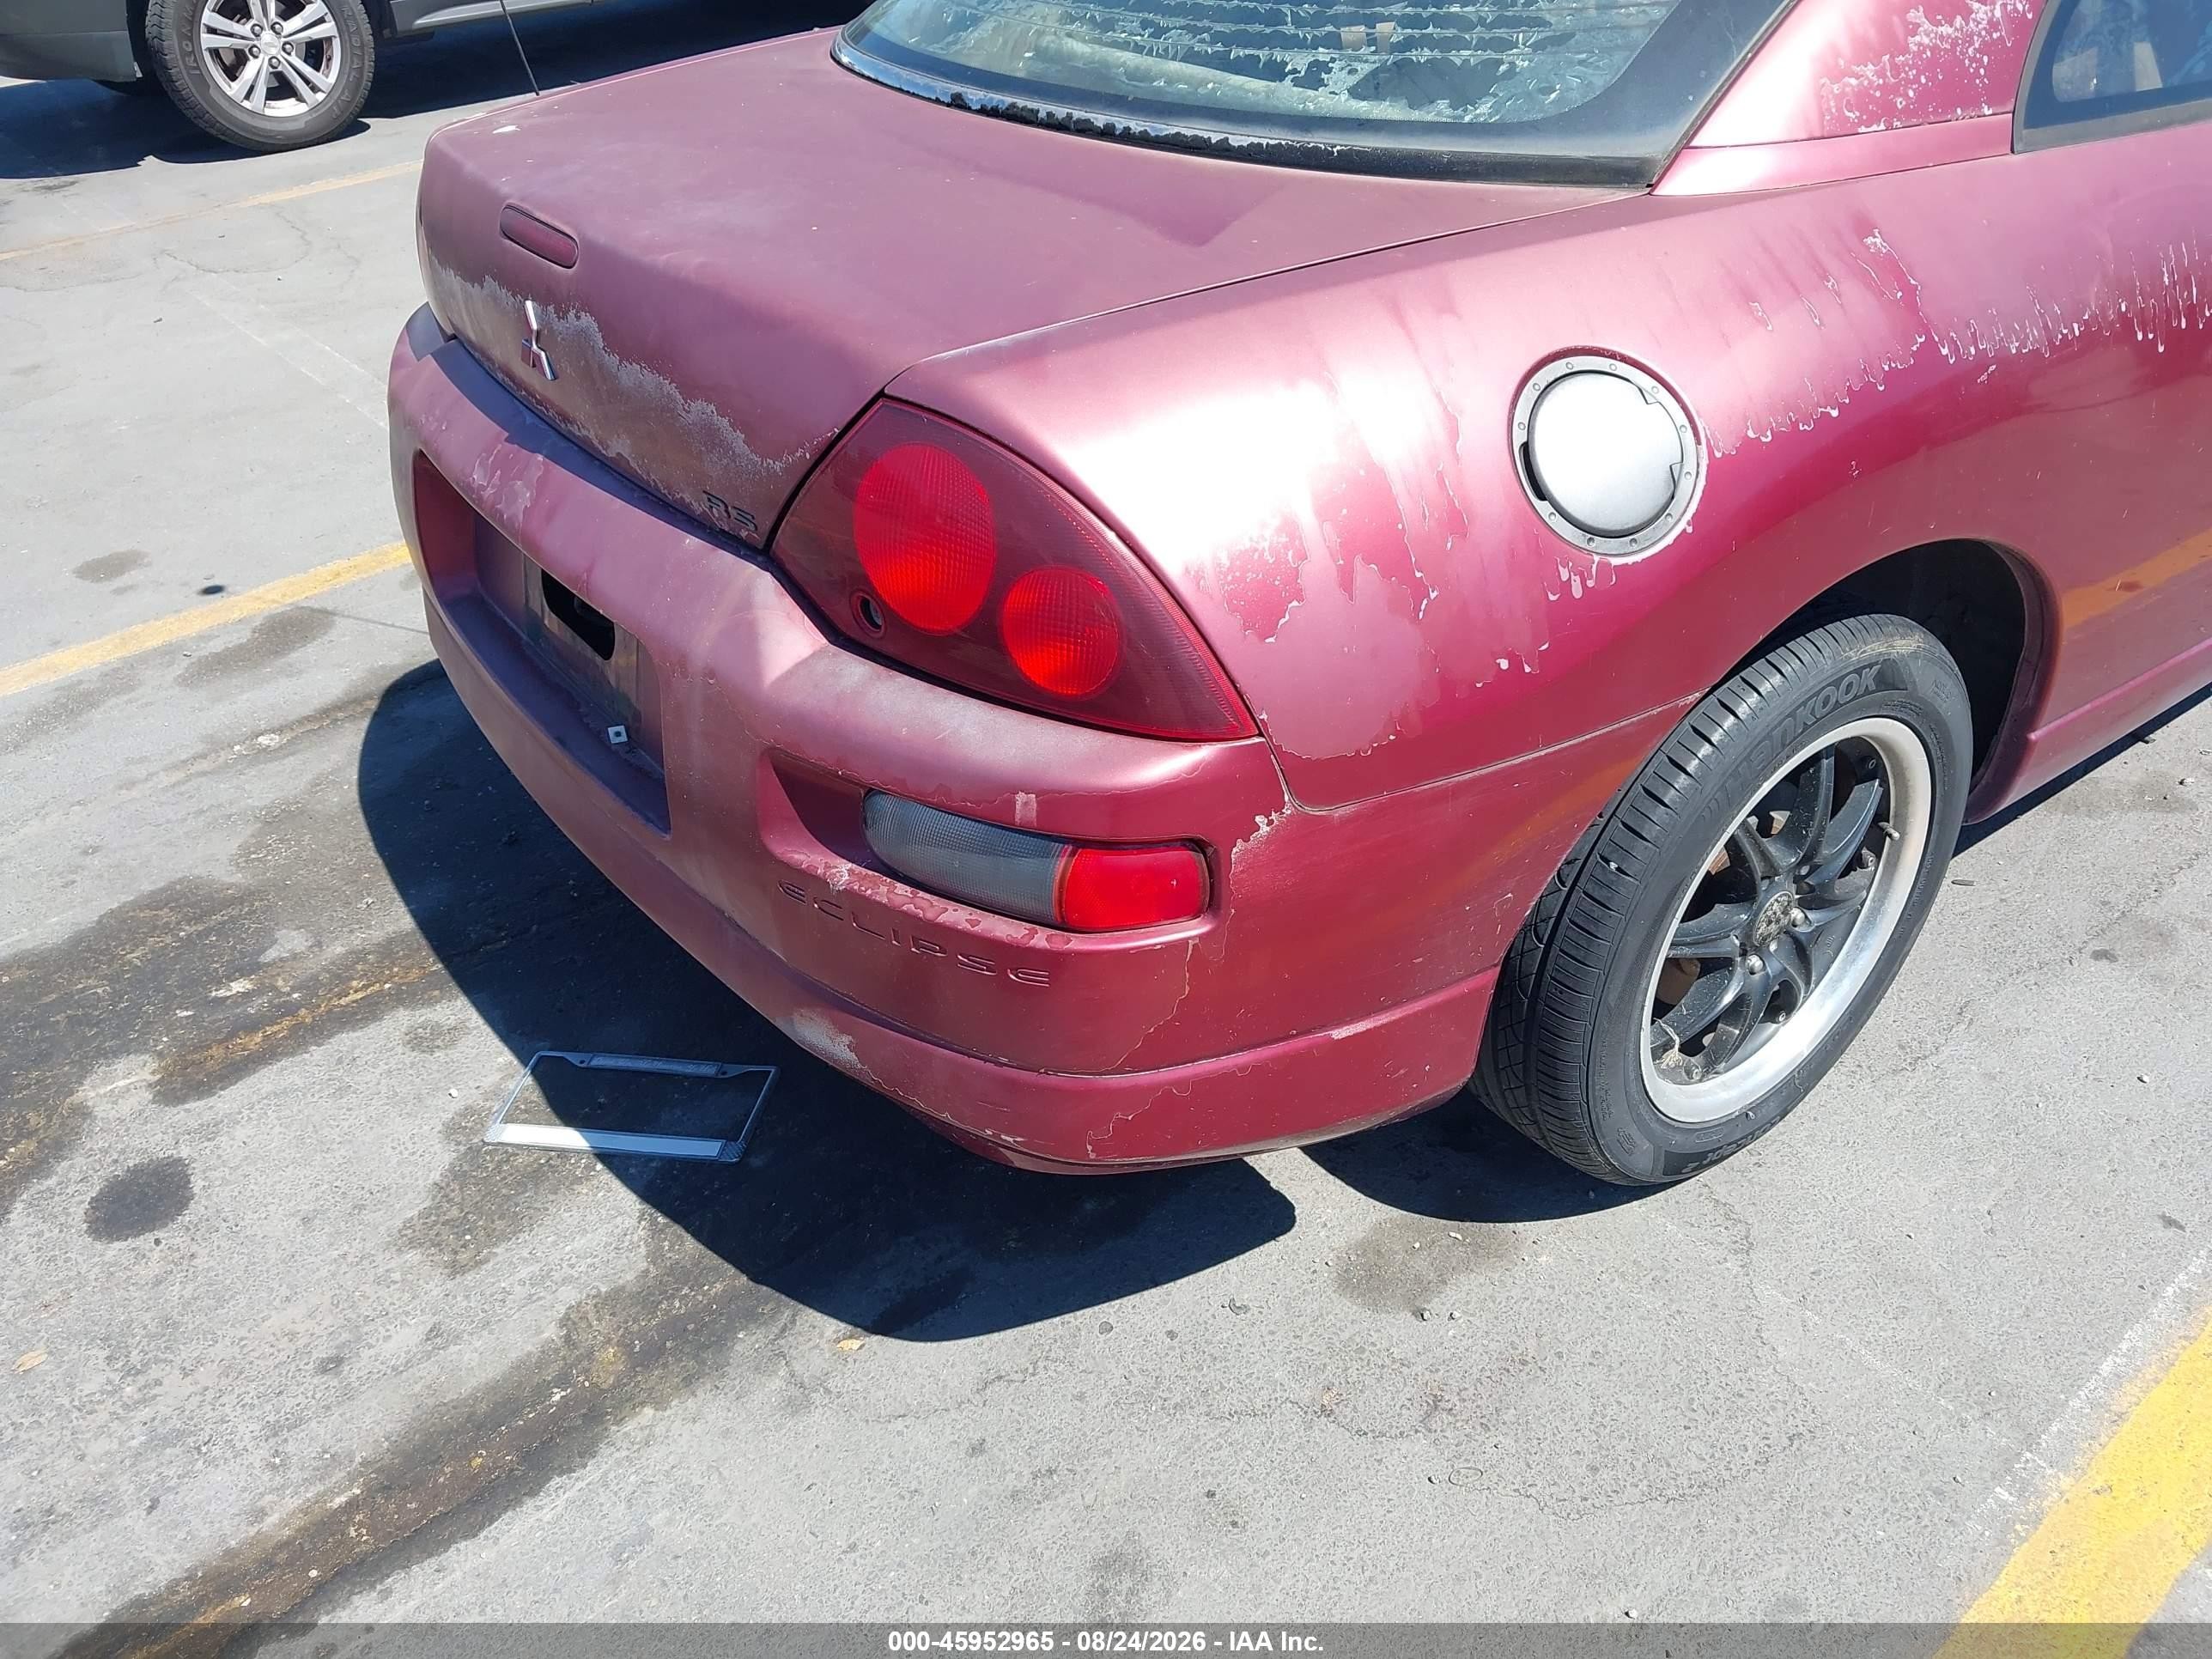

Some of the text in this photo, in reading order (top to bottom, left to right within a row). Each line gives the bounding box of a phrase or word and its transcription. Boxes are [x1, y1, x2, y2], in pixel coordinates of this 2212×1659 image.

[341, 5, 362, 82] RADIAL
[702, 490, 758, 532] RS
[777, 879, 1051, 988] ECLIPSE
